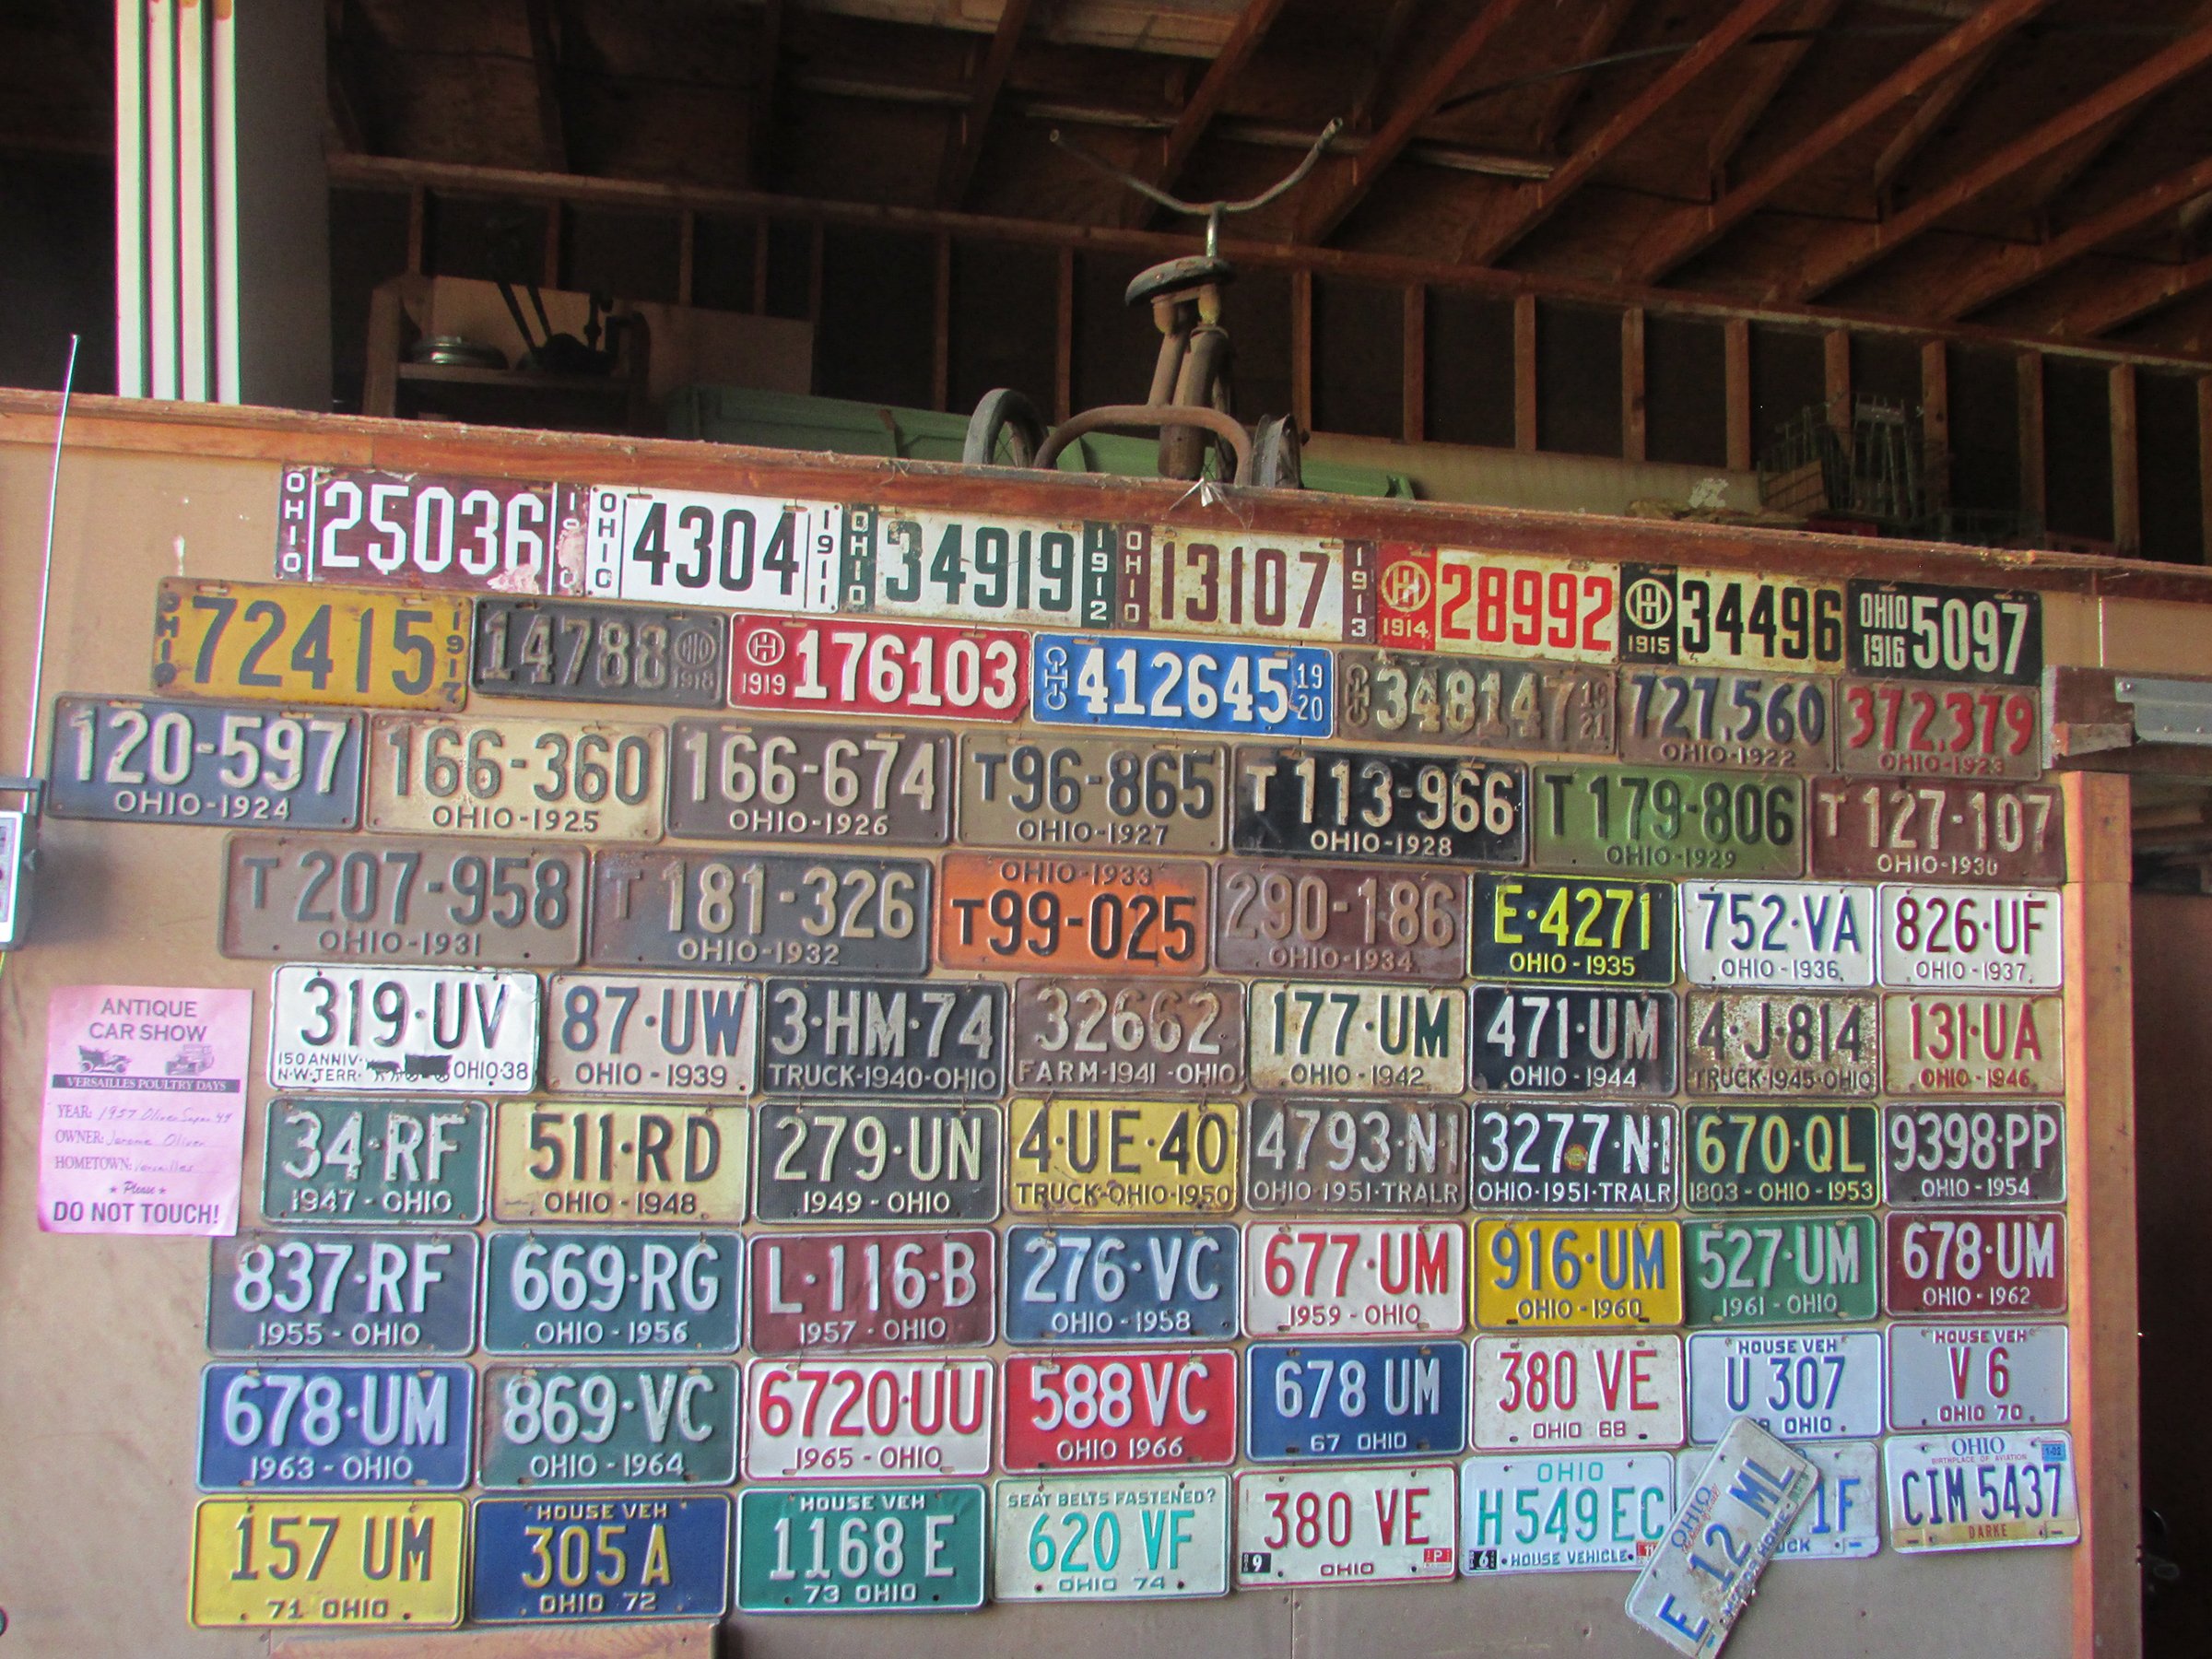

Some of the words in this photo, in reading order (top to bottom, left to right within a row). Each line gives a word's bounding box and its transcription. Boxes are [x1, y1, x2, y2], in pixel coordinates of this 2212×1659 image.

[322, 481, 546, 581] 25036
[633, 503, 799, 596] 4304
[885, 520, 1075, 613] 34919
[1161, 541, 1331, 629] 13107
[1441, 563, 1613, 652] 28992
[1681, 580, 1842, 663] 34496
[1860, 592, 1908, 630] OHIO
[192, 594, 435, 696] 72415
[1382, 616, 1430, 638] 1914
[1628, 635, 1670, 654] 1915
[1912, 595, 2029, 676] 5097
[480, 607, 667, 691] 14788
[1863, 634, 1905, 668] 1916
[742, 673, 786, 696] 1919
[794, 629, 1018, 709] 176103
[1077, 647, 1289, 724] 412645
[1376, 663, 1575, 742] 348147
[68, 704, 348, 794] 120-597
[388, 725, 650, 805] 166-360
[685, 731, 935, 812] 166-674
[952, 890, 1195, 962] T99-025
[1225, 872, 1455, 948] 290-186
[100, 998, 198, 1018] ANTIQUE
[1037, 986, 1222, 1055] 32662
[88, 1023, 135, 1040] CAR
[139, 1024, 207, 1041] SHOW
[65, 1077, 135, 1088] VERSAILLES
[138, 1078, 193, 1090] POULTRY
[195, 1080, 227, 1091] DAYS
[57, 1104, 92, 1118] YEAR:
[55, 1130, 104, 1144] OWNER:
[54, 1156, 133, 1171] HOMETOWN:
[124, 1182, 156, 1195] Please
[53, 1201, 83, 1221] DO
[92, 1203, 134, 1222] NOT
[141, 1203, 219, 1224] TOUCH!
[1737, 1339, 1795, 1355] HOUSE
[1801, 1338, 1837, 1353] VEH
[1934, 1330, 1990, 1345] HOUSE
[1994, 1329, 2028, 1343] VEH
[1275, 1359, 1367, 1418] 678
[1384, 1358, 1440, 1417] UM
[1499, 1349, 1577, 1413] 380
[1594, 1348, 1659, 1411] VE
[1724, 1357, 1750, 1412] U
[1767, 1356, 1845, 1411] 307
[1947, 1347, 1971, 1401] V
[1985, 1347, 2010, 1399] 6
[1532, 1422, 1582, 1440] OHIO
[1598, 1420, 1627, 1438] 68
[1784, 1418, 1832, 1434] OHIO
[1939, 1404, 1985, 1422] OHIO
[1994, 1404, 2023, 1420] 70
[1056, 1439, 1117, 1461] OHIO
[1128, 1437, 1184, 1459] 1966
[1309, 1434, 1340, 1453] 67
[1358, 1432, 1406, 1451] OHIO
[1932, 1456, 1975, 1465] BIRTHPLACE
[1951, 1436, 2005, 1455] OHIO
[1537, 1461, 1605, 1482] OHIO
[1725, 1455, 1796, 1520] ML
[537, 1504, 612, 1520] HOUSE
[622, 1503, 668, 1519] VEH
[800, 1496, 876, 1512] HOUSE
[882, 1495, 925, 1510] VEH
[1007, 1493, 1053, 1508] SEAT
[1058, 1491, 1110, 1507] BELTS
[1115, 1488, 1217, 1505] FASTENED?
[1901, 1466, 1968, 1525] CIM
[1977, 1463, 2061, 1520] 5437
[1264, 1491, 1352, 1549] 380
[1374, 1488, 1430, 1547] VE
[1610, 1486, 1665, 1542] EC
[1671, 1486, 1712, 1548] OHIO
[1969, 1524, 2007, 1539] DARKE
[230, 1515, 339, 1582] 157
[363, 1515, 434, 1582] UM
[522, 1525, 628, 1588] 305
[641, 1524, 671, 1586] A
[770, 1517, 904, 1582] 1168
[924, 1515, 955, 1578] E
[1028, 1511, 1121, 1572] 620
[1141, 1509, 1195, 1571] VF
[1511, 1552, 1560, 1567] HOUSE
[1567, 1549, 1628, 1564] VEHICLE
[1058, 1577, 1117, 1593] OHIO
[1134, 1576, 1165, 1591] 74
[1320, 1562, 1374, 1577] OHIO
[266, 1601, 304, 1619] 71
[321, 1599, 390, 1618] OHIO
[539, 1594, 604, 1614] OHIO
[623, 1593, 658, 1612] 72
[804, 1586, 840, 1604] 73
[854, 1583, 917, 1603] OHIO
